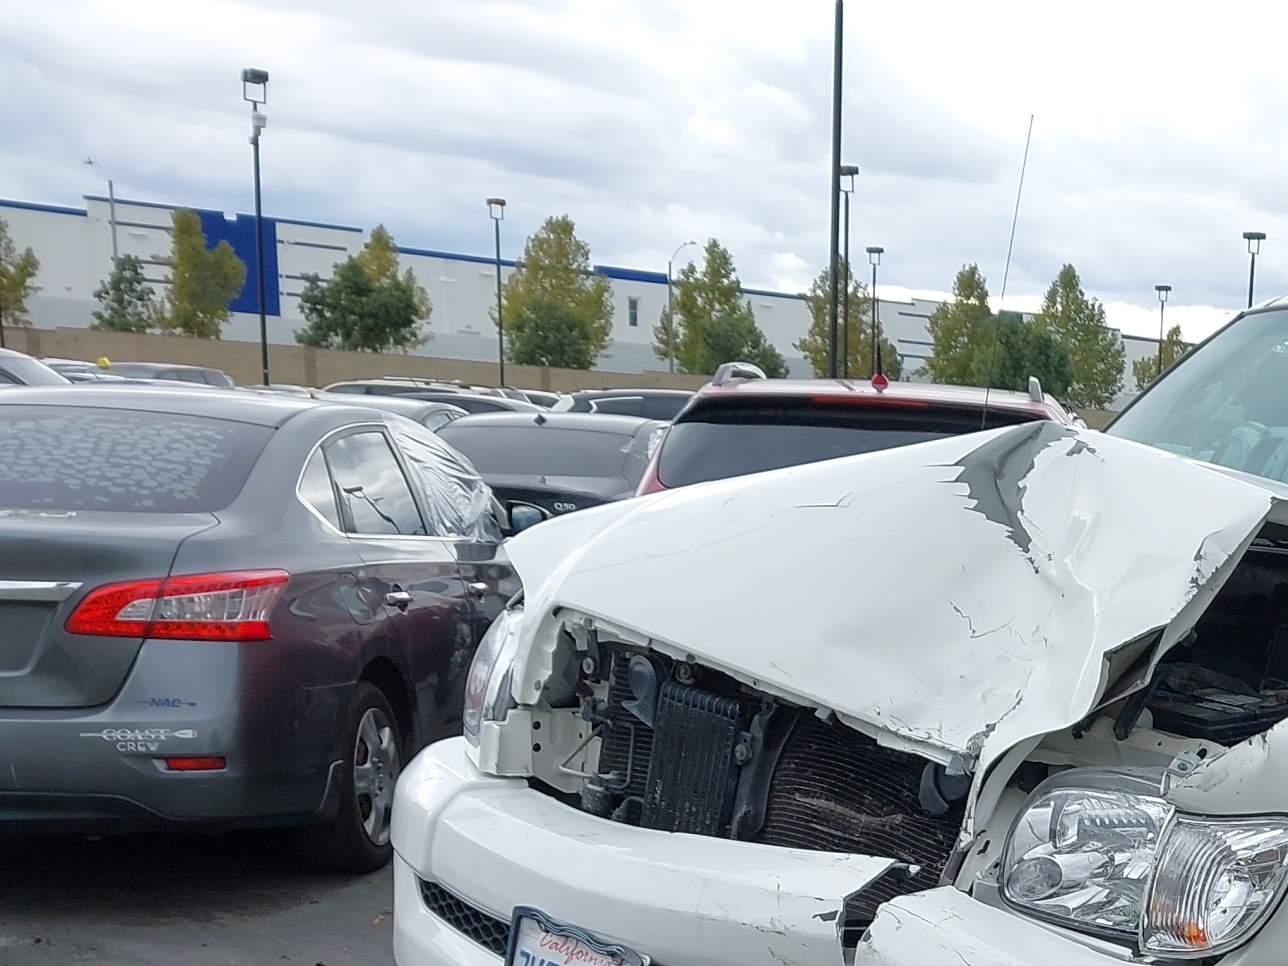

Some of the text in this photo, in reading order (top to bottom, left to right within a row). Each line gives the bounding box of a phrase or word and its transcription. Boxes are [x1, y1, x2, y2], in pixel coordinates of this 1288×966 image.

[554, 502, 576, 512] Q50
[101, 728, 171, 740] COAST
[116, 741, 160, 752] CREW
